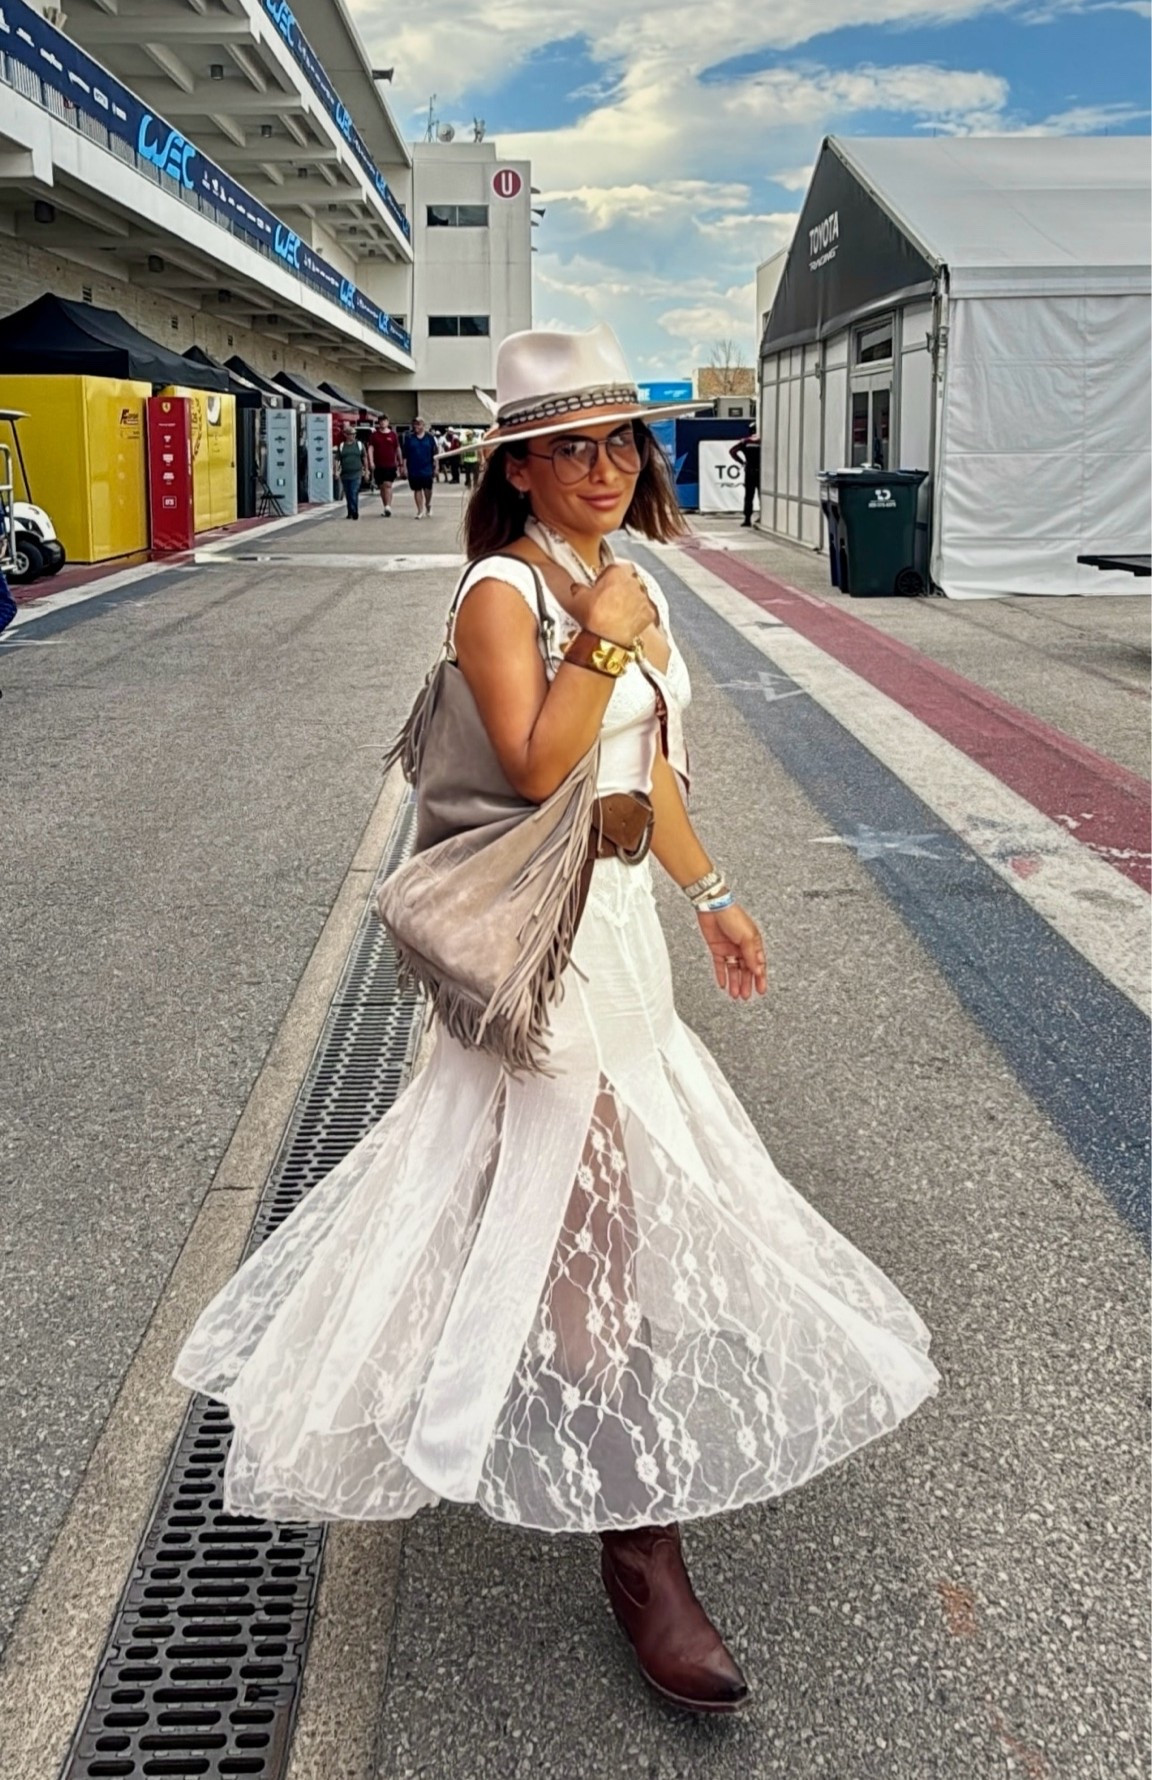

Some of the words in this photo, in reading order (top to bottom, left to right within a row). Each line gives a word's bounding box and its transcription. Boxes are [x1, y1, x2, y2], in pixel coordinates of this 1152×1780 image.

[138, 114, 196, 189] WEC
[501, 172, 512, 196] U
[274, 224, 301, 270] WEC
[809, 211, 839, 256] TOYOTA
[340, 278, 356, 310] WEC
[714, 465, 741, 480] TO
